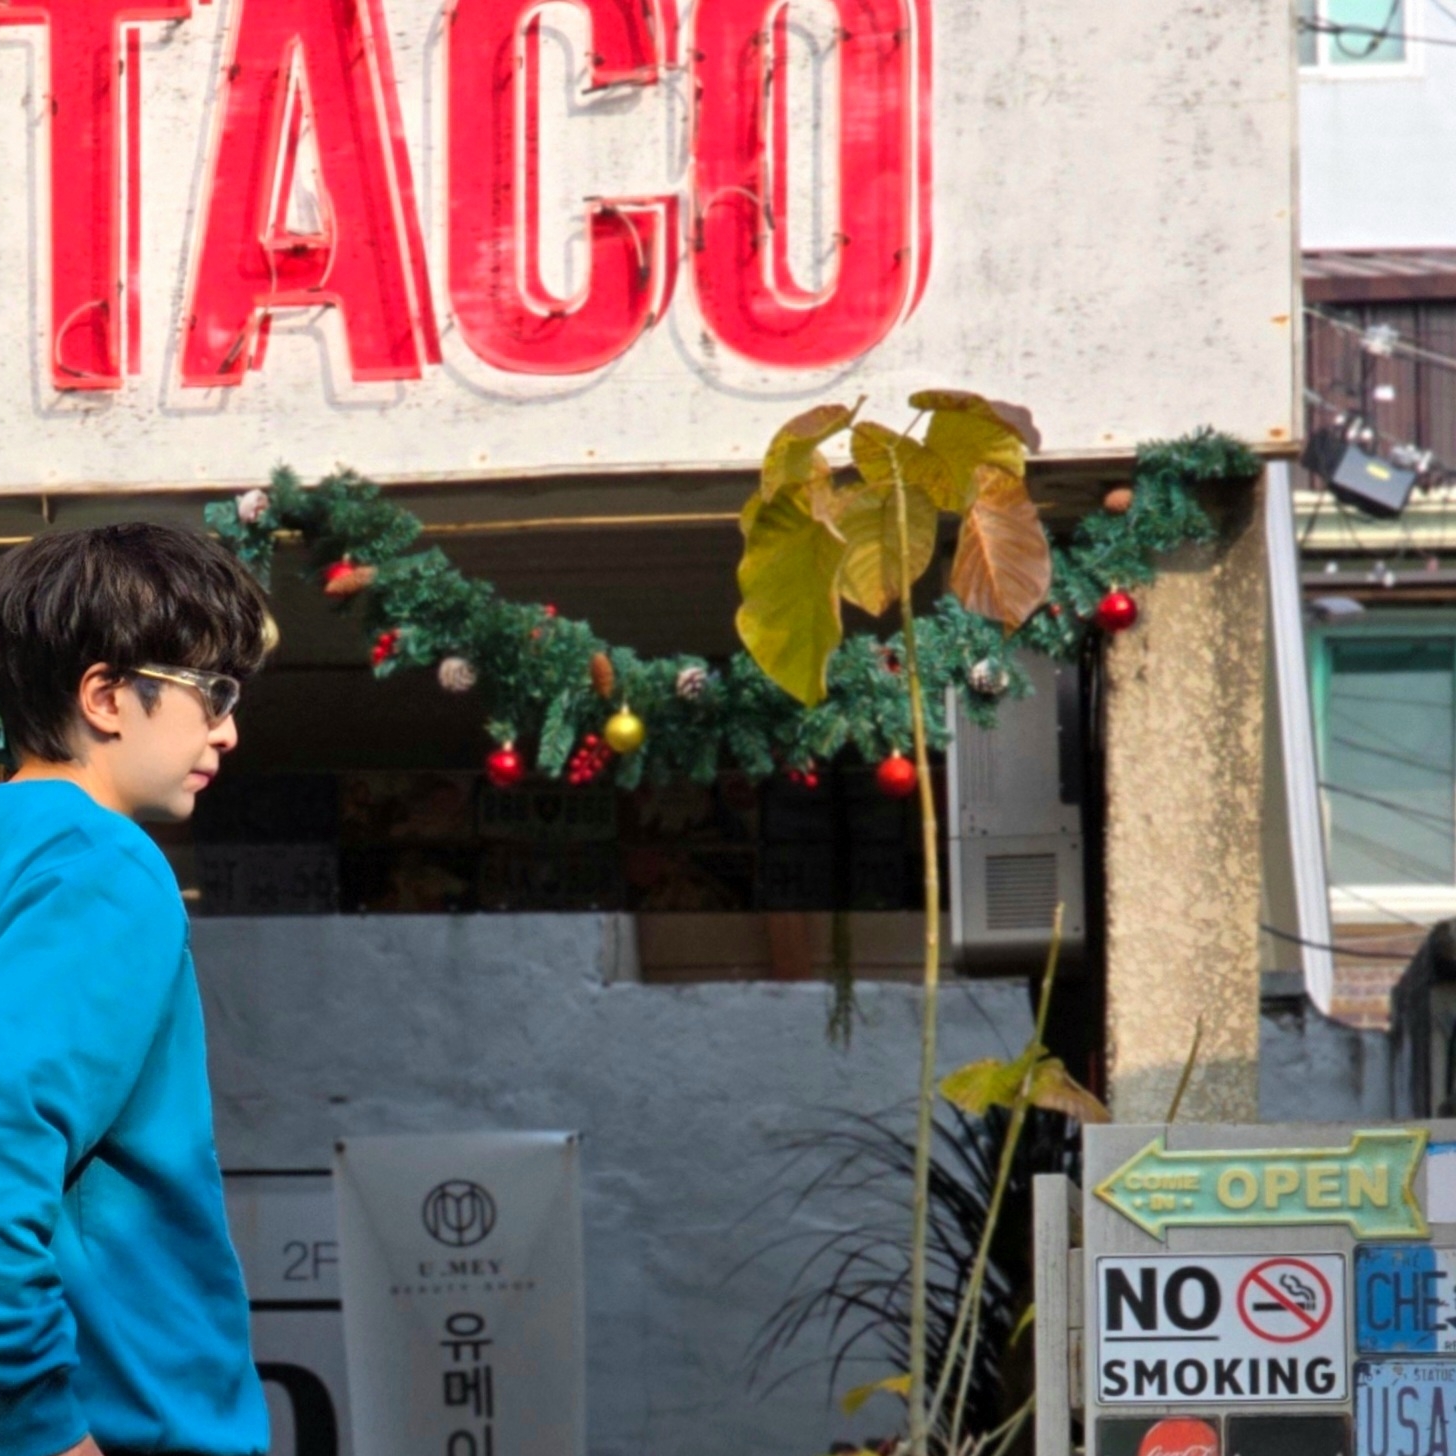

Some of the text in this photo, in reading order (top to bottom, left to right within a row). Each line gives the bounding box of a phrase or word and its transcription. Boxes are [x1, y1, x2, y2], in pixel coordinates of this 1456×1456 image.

[1124, 1171, 1202, 1191] COME
[1217, 1163, 1389, 1209] OPEN
[1149, 1194, 1175, 1211] IN
[1105, 1265, 1222, 1332] NO
[1102, 1356, 1337, 1397] SMOKING
